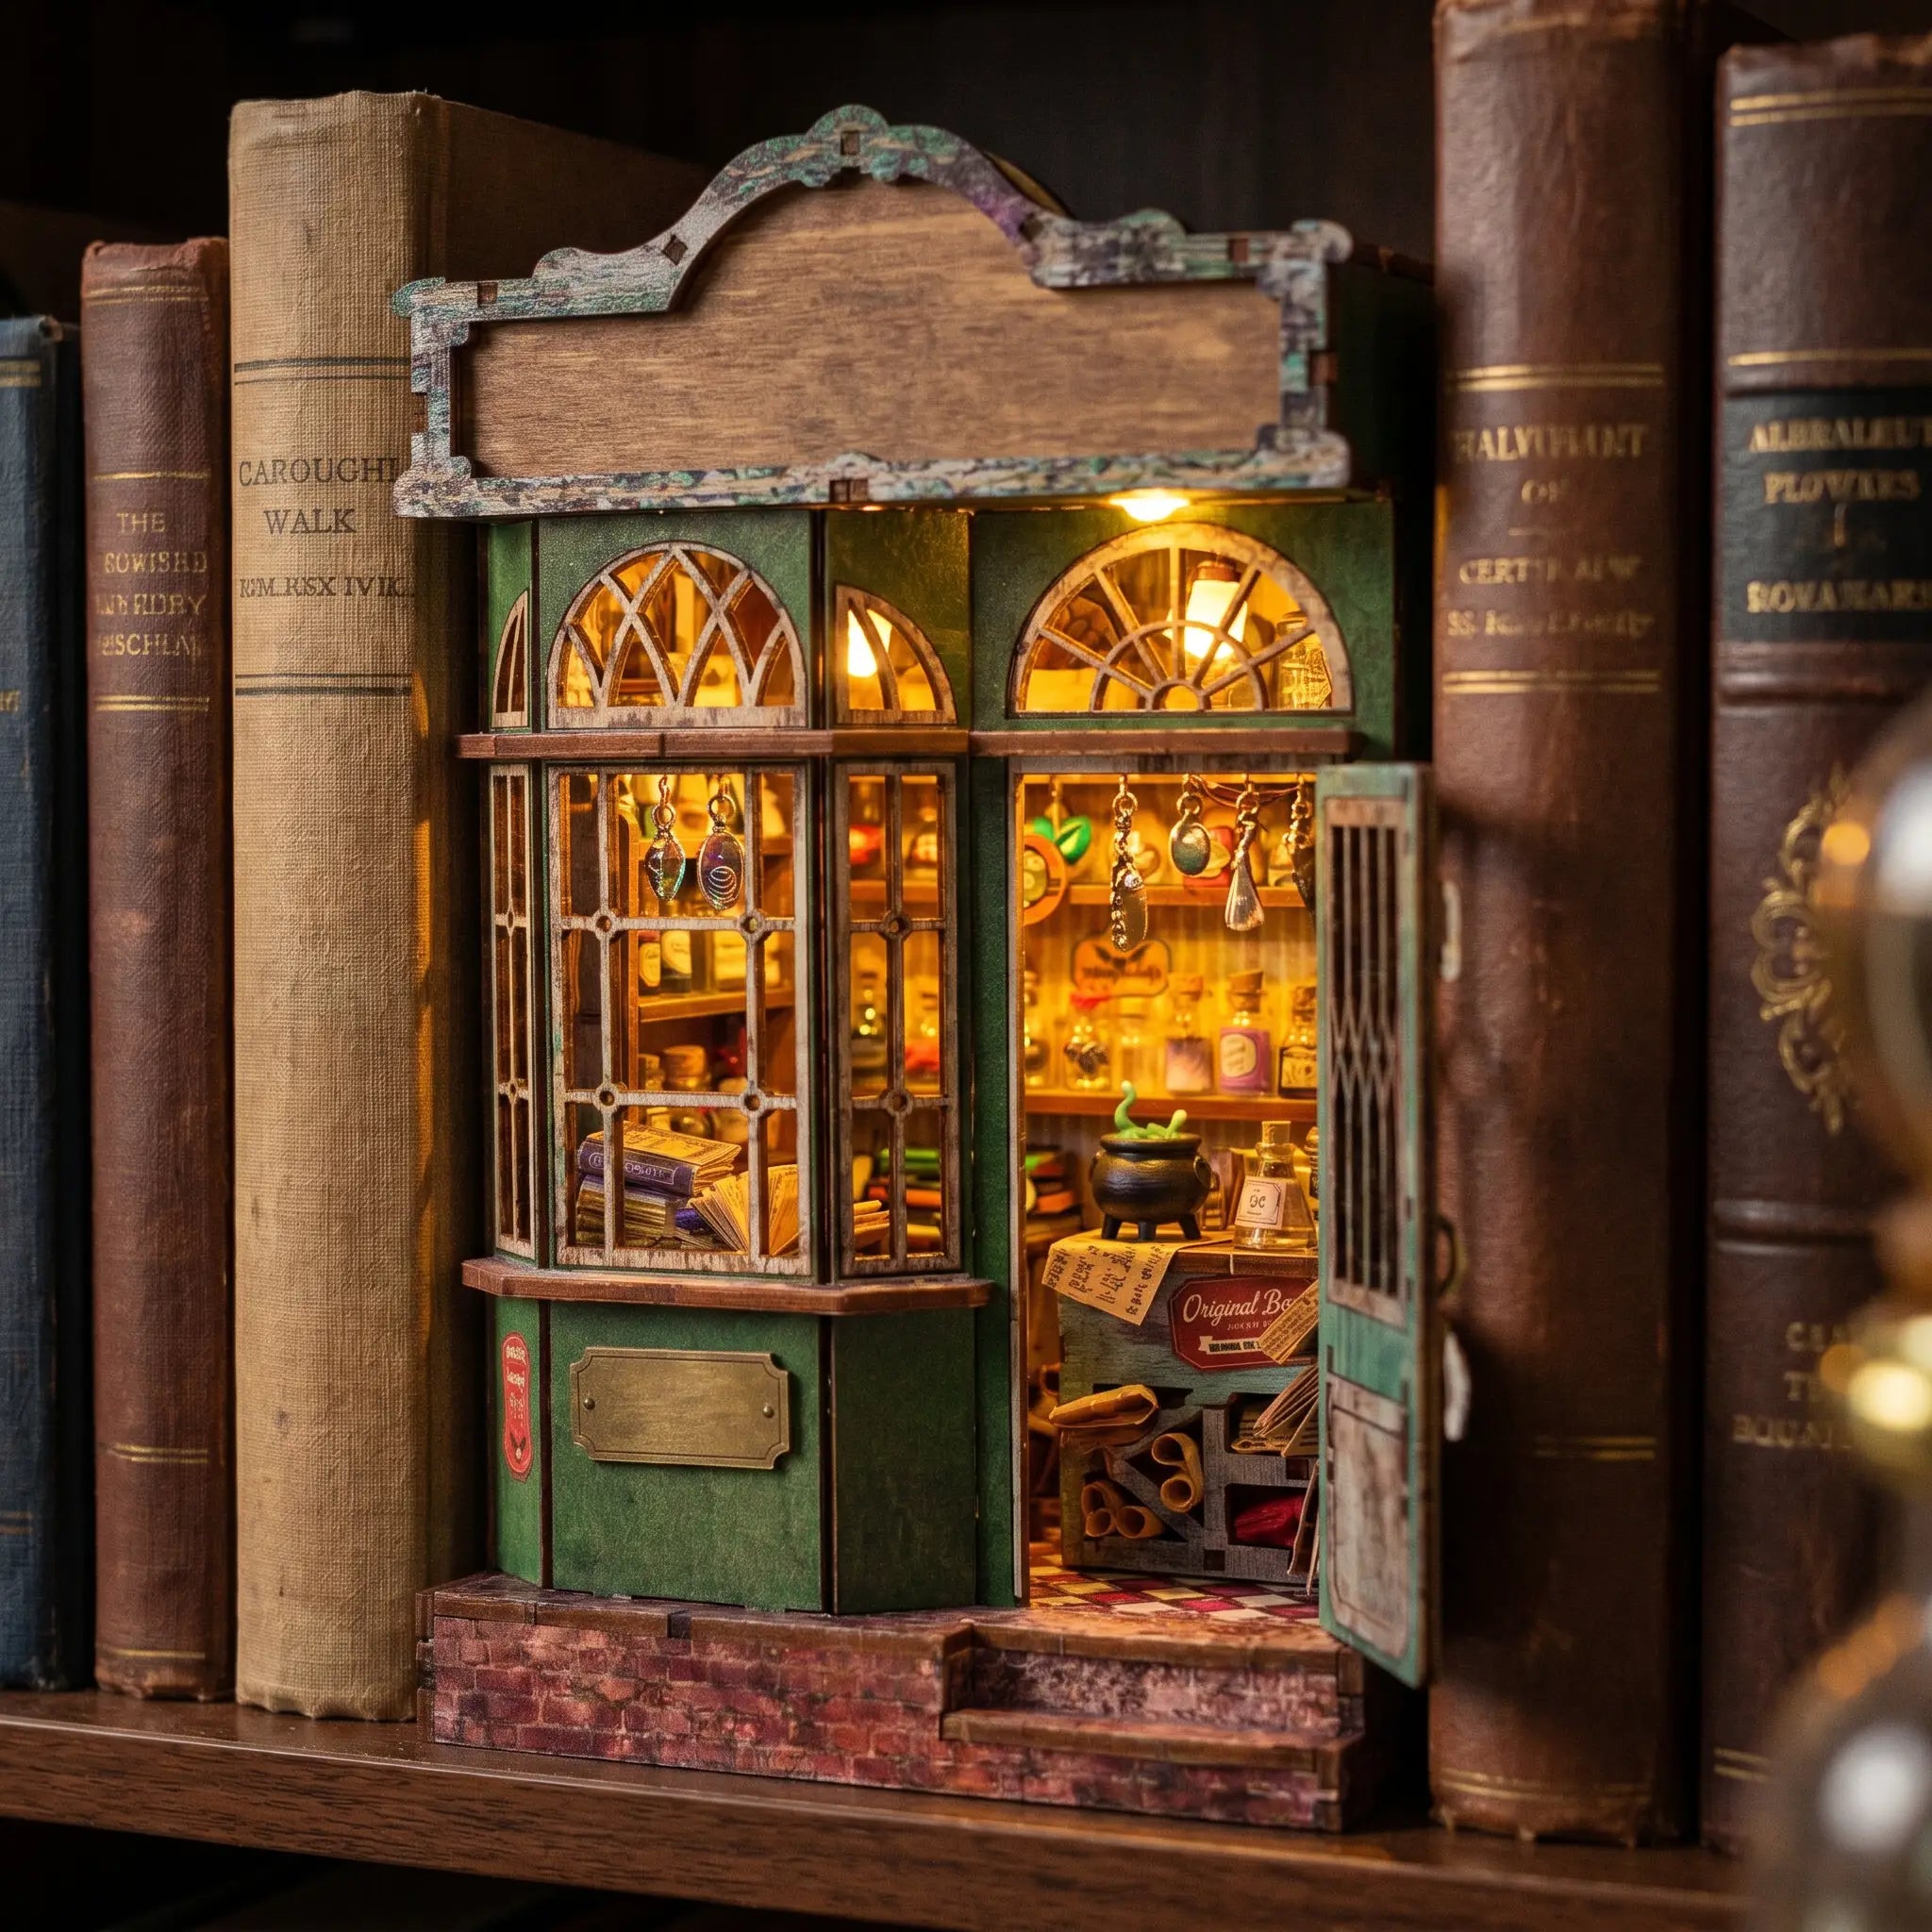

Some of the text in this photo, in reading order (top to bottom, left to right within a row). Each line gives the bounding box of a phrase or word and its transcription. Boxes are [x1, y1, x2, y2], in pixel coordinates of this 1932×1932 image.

[116, 512, 167, 534] THE
[263, 508, 357, 535] WALK
[1183, 1290, 1261, 1326] Original
[1261, 1289, 1296, 1316] Bo
